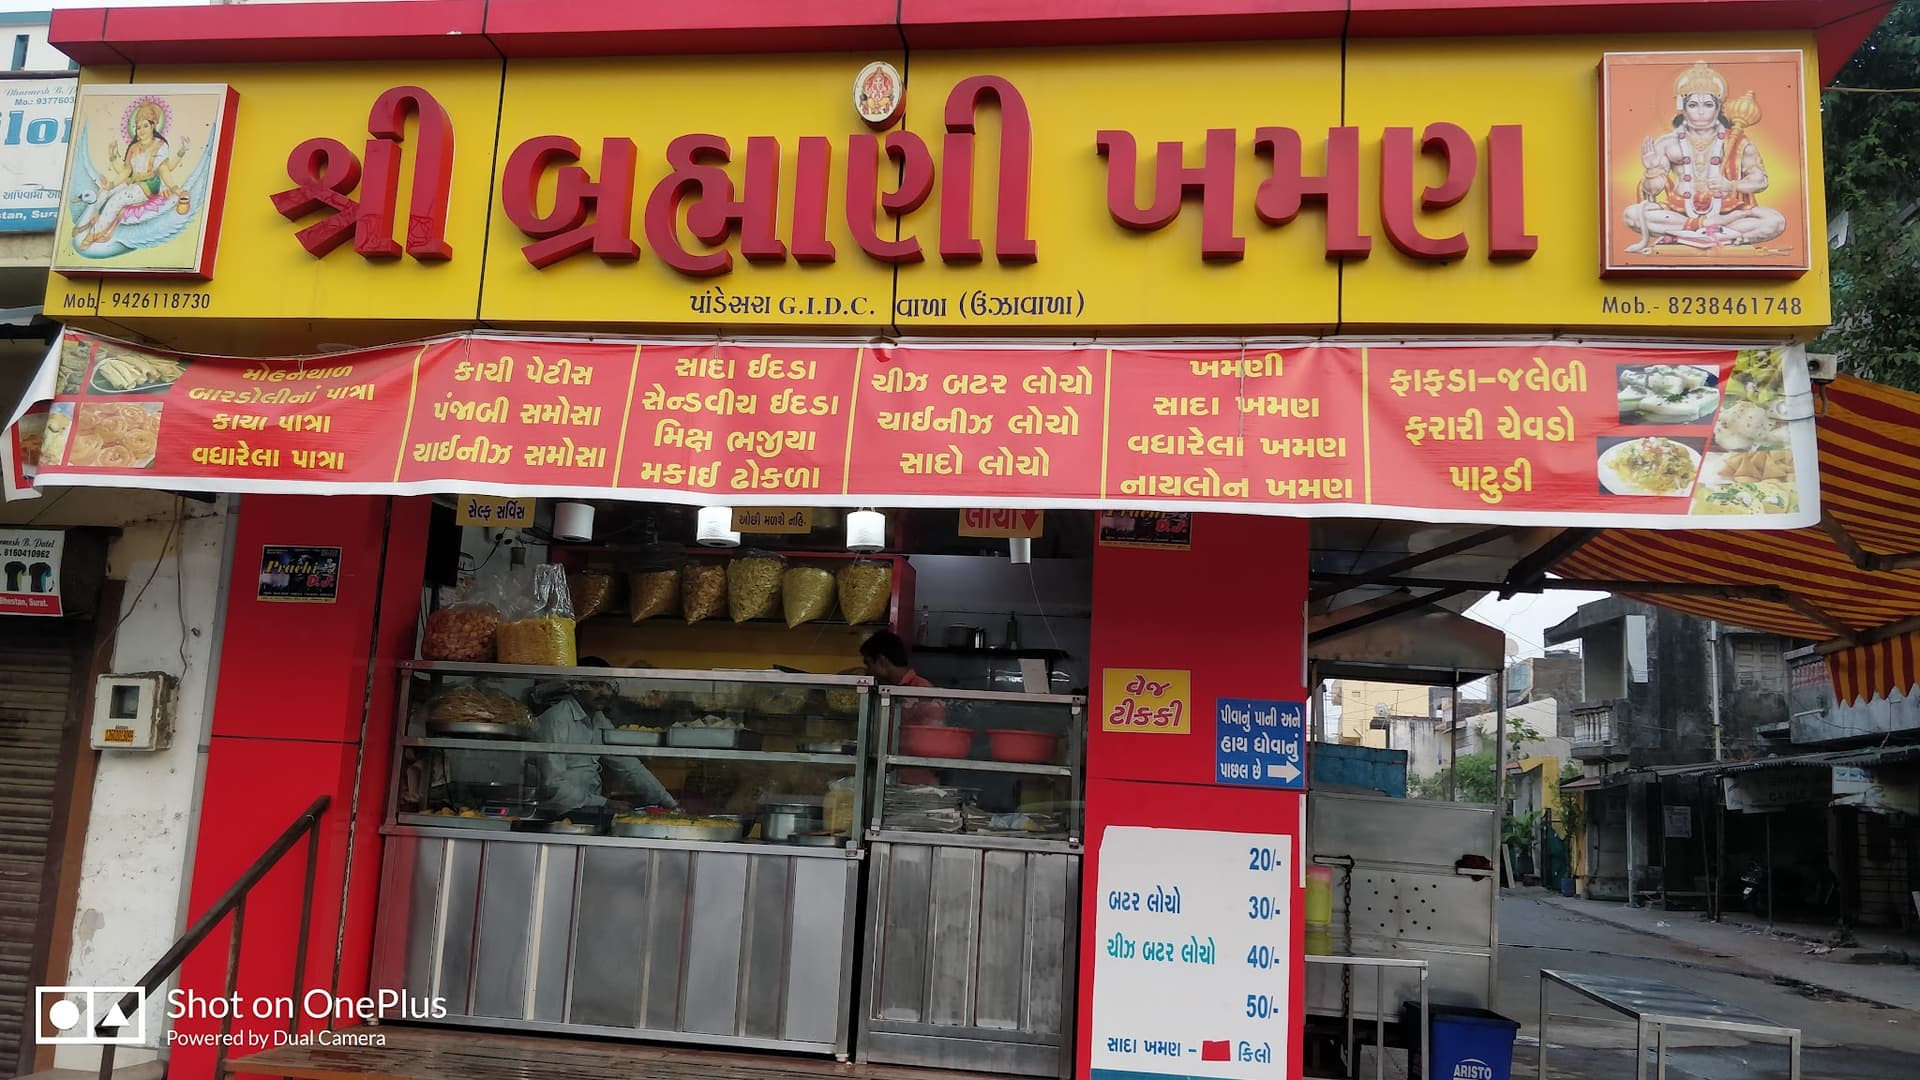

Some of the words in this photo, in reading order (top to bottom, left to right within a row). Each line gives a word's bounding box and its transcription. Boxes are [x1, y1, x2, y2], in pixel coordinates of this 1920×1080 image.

[270, 85, 455, 260] શ્રી
[502, 75, 1038, 277] બ્રહ્માણી
[1096, 122, 1538, 260] ખમણ
[112, 292, 210, 309] 9426118730
[690, 286, 770, 314] પાંડેસરા
[779, 297, 875, 315] G.I.D.C.
[897, 299, 947, 318] વાળા
[1669, 297, 1801, 314] 8238461748
[455, 356, 513, 383] કાચી
[526, 356, 593, 385] પેટીસ
[676, 357, 735, 380] સાદા
[748, 354, 816, 380] ઈદડા
[1190, 353, 1284, 377] ખમણી
[326, 384, 375, 401] પાત્રા
[872, 368, 928, 393] ચીઝ
[943, 373, 1006, 394] બટર
[1022, 366, 1093, 395] લોચો
[433, 393, 509, 424] પંજાબી
[520, 396, 601, 427] સમોસા
[642, 384, 756, 415] સેન્ડવીચ
[769, 388, 839, 416] ઈદડા
[1153, 396, 1219, 415] સાદા
[1238, 396, 1320, 417] ખમણ
[212, 412, 266, 431] કાચા
[279, 414, 330, 433] પાત્રા
[877, 408, 993, 434] ચાઈનીઝ
[1008, 406, 1079, 436] લોચો
[1405, 411, 1483, 445] ફરારી
[1497, 406, 1575, 441] ચેવડો
[413, 434, 512, 466] ચાઈનીઝ
[524, 436, 606, 468] સમોસા
[654, 419, 713, 450] મિક્ષ
[727, 429, 816, 457] ભજીયા
[1128, 428, 1244, 456] વધારેલા
[1260, 437, 1346, 457] ખમણ
[192, 440, 279, 467] વધારેલા
[291, 449, 345, 470] પાત્રા
[900, 445, 963, 475] સાદો
[978, 447, 1050, 476] લોચો
[641, 462, 721, 488] મકાઈ
[731, 459, 820, 490] ઢોકળા
[1121, 468, 1249, 497] નાયલોન
[1266, 478, 1353, 499] ખમણ
[1450, 457, 1532, 503] પાટુડી
[468, 499, 492, 521] સેલ્ફ
[497, 500, 525, 519] સર્વિસ
[1126, 674, 1171, 697] વેજ
[1109, 698, 1183, 728] ટીકકી
[1221, 704, 1251, 732] પીવાનું
[1254, 709, 1277, 727] પાની
[1281, 707, 1300, 728] અને
[1221, 737, 1247, 753] હાથ
[1254, 732, 1299, 762] ધોવાનું
[1221, 762, 1248, 779] પાછલ
[1252, 758, 1261, 780] છે
[1249, 848, 1281, 871] 20/-
[1108, 890, 1140, 911] બટર
[1147, 885, 1181, 914] લોચો
[1248, 896, 1280, 920] 30/-
[1107, 932, 1136, 959] ચીઝ
[1143, 941, 1174, 962] બટર
[1181, 936, 1215, 965] લોચો
[1247, 945, 1280, 969] 40/-
[1246, 995, 1279, 1019] 50/-
[1107, 1037, 1137, 1053] સાદા
[1144, 1039, 1181, 1057] ખમણ
[1238, 1040, 1271, 1063] કિલો
[1454, 1064, 1492, 1080] ARISTO
